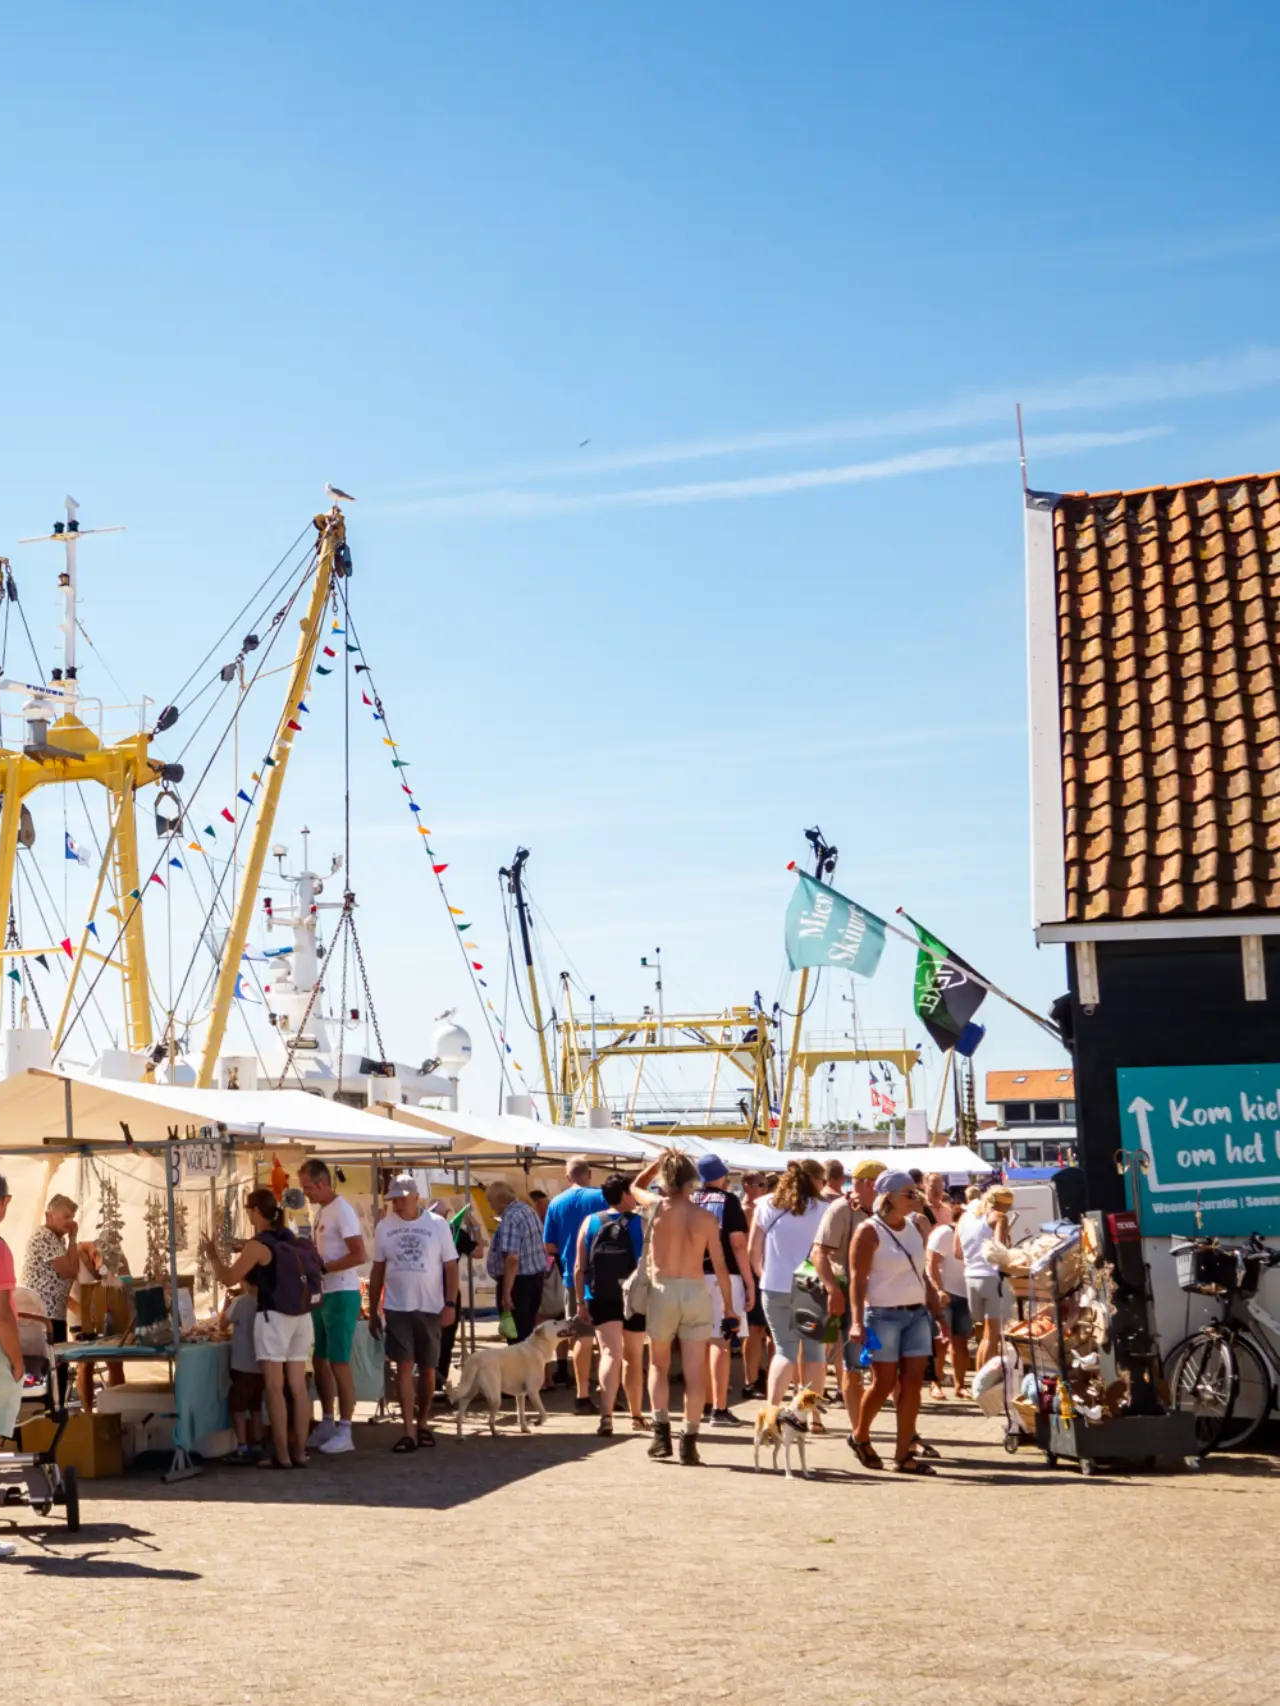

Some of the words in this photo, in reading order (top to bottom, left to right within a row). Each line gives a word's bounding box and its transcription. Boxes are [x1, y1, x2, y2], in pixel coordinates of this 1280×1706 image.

[1169, 1096, 1232, 1129] Kom
[1176, 1147, 1216, 1168] om
[1225, 1131, 1266, 1164] het
